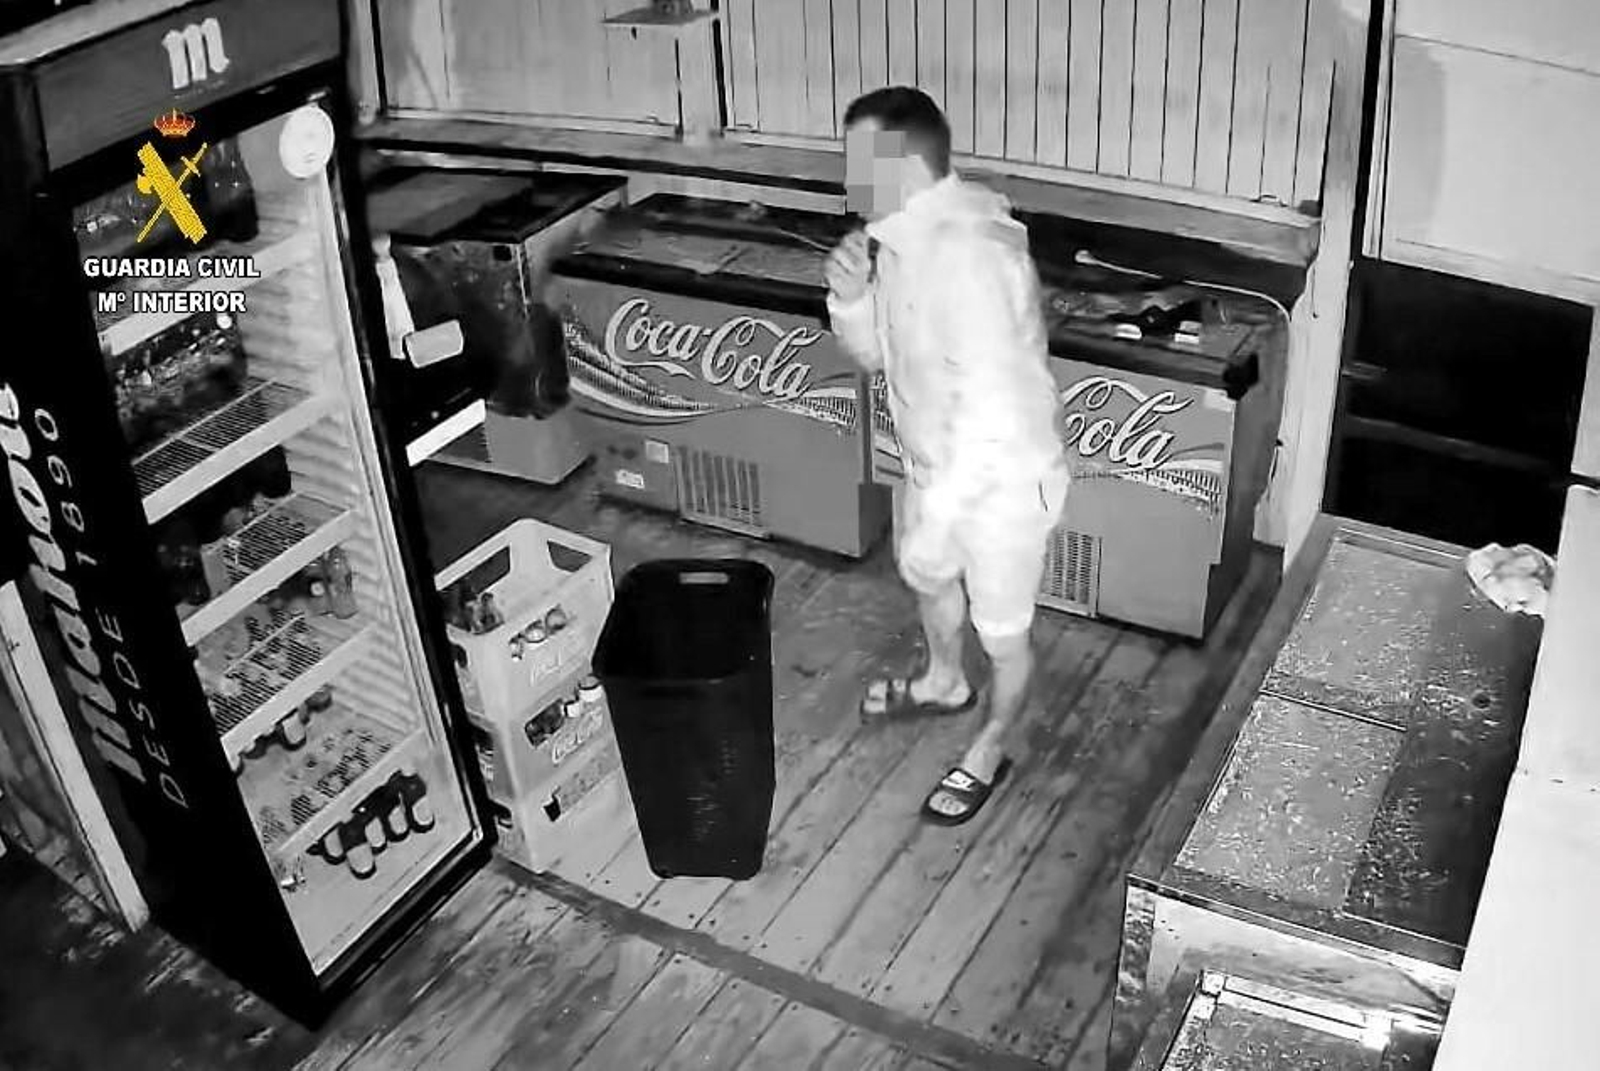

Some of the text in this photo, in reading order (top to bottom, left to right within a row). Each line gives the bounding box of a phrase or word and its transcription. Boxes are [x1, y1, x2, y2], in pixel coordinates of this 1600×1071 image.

[604, 298, 824, 399] Coca-Cola
[34, 408, 190, 809] DESDE 1890
